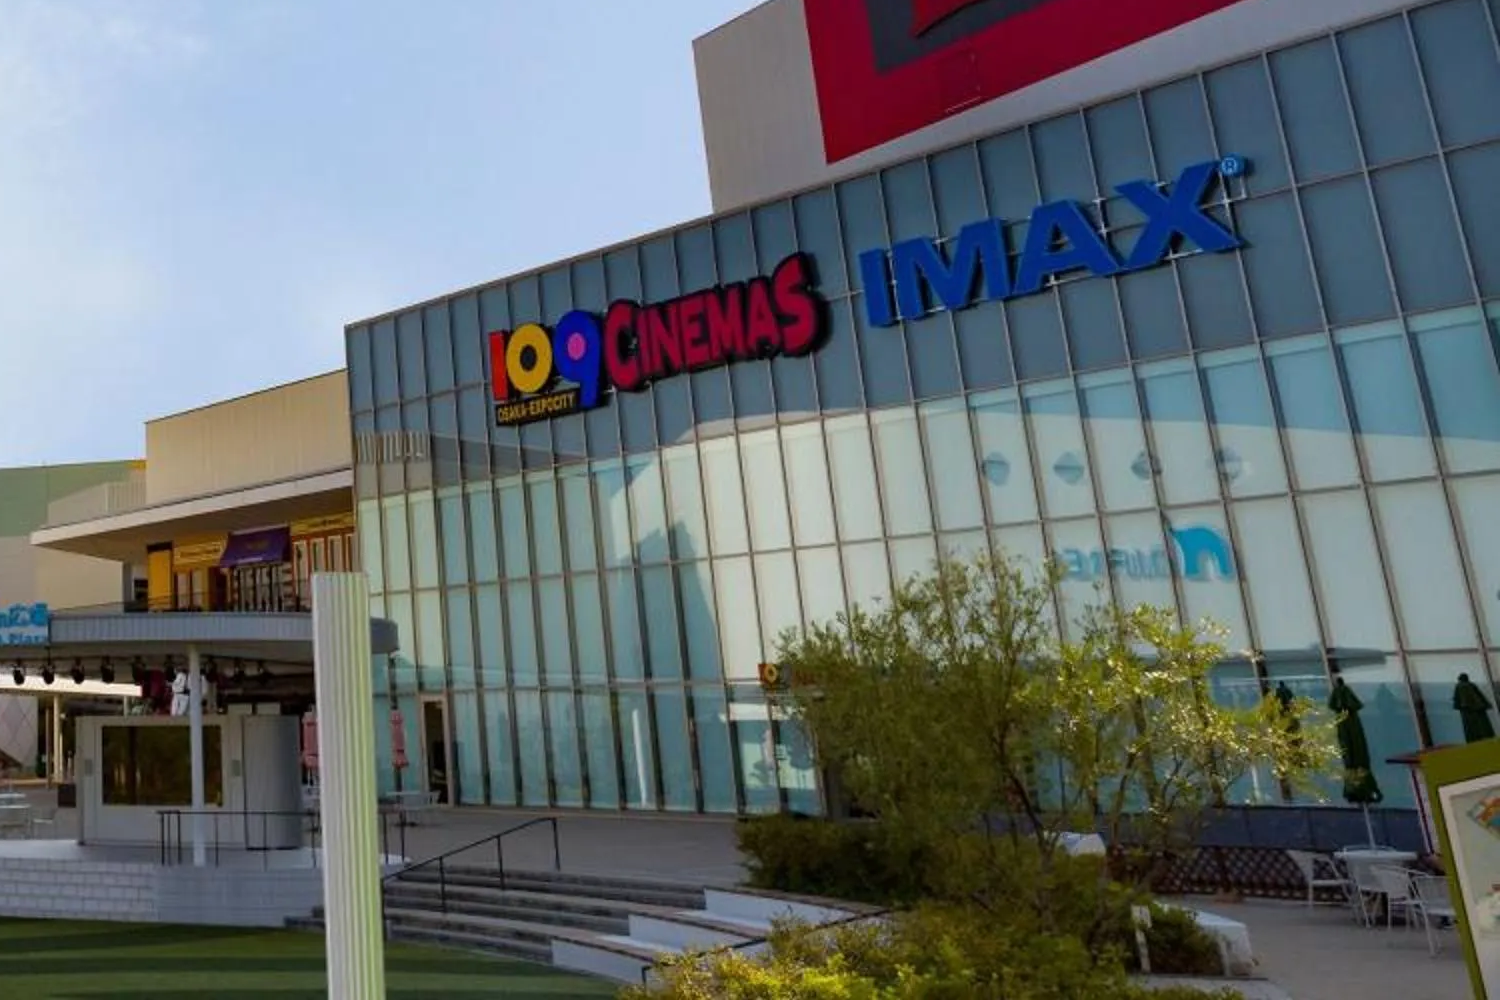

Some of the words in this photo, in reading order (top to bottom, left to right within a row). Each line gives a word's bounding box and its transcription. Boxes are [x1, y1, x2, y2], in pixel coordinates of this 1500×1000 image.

[859, 161, 1242, 327] IMAX
[489, 309, 601, 408] 109
[604, 252, 817, 392] CINEMAS
